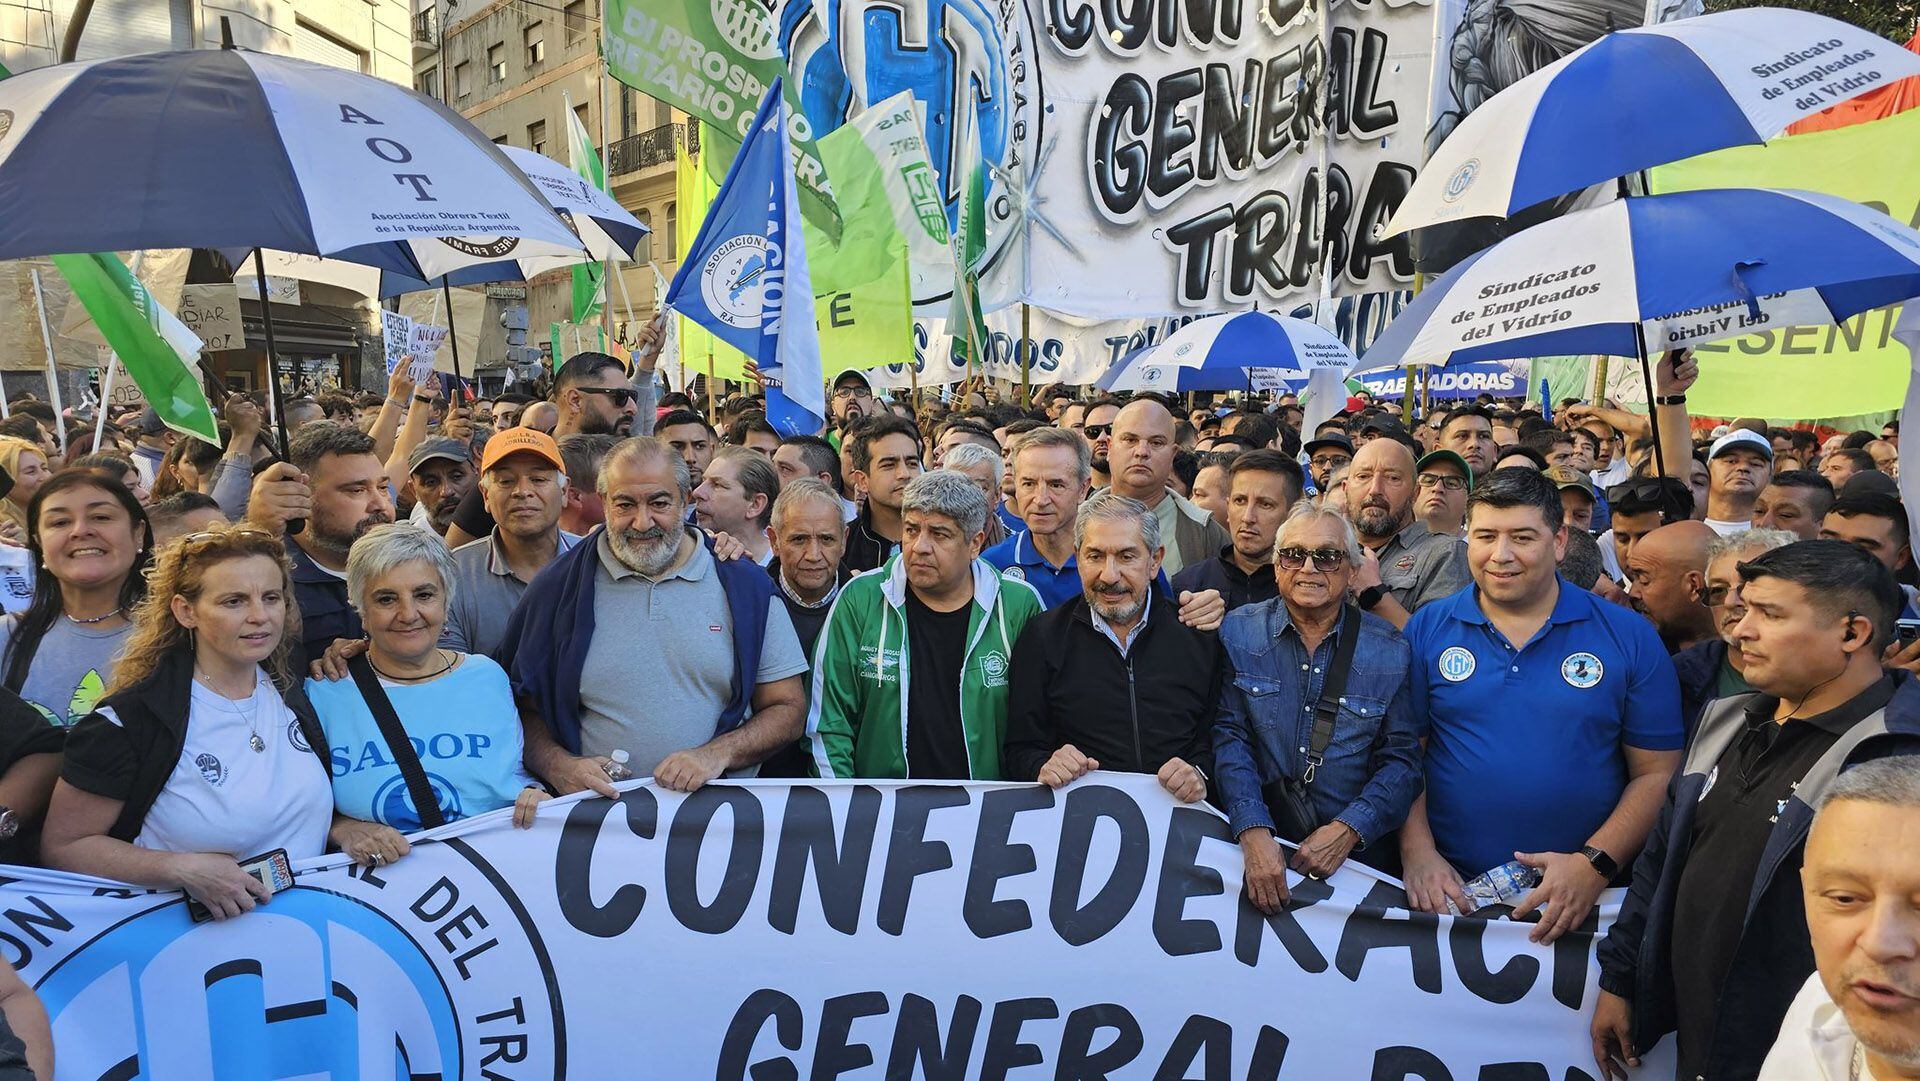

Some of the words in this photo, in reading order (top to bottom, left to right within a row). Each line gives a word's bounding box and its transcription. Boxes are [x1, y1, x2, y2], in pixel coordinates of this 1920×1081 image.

[609, 34, 735, 121] RETARIO
[1751, 38, 1843, 78] Sindicato
[1762, 87, 1784, 100] de
[1780, 49, 1876, 91] Empleados
[659, 25, 813, 142] PROSPO
[1795, 92, 1826, 110] del
[1819, 71, 1882, 97] Vidrio
[994, 29, 1028, 221] TRABAO
[1095, 27, 1398, 214] GENERAL
[371, 211, 437, 221] Asociación
[439, 211, 478, 220] Obrera
[480, 212, 511, 221] Textil
[375, 225, 391, 233] de
[393, 225, 406, 233] la
[409, 223, 466, 234] República
[468, 224, 521, 233] Argentina
[1478, 263, 1597, 300] Sindicato
[1451, 310, 1475, 324] de
[1481, 282, 1600, 318] Empleados
[1461, 323, 1495, 342] del
[1502, 309, 1573, 333] Vidrio
[1364, 372, 1514, 396] RABAADORAS
[409, 875, 500, 982] DEL
